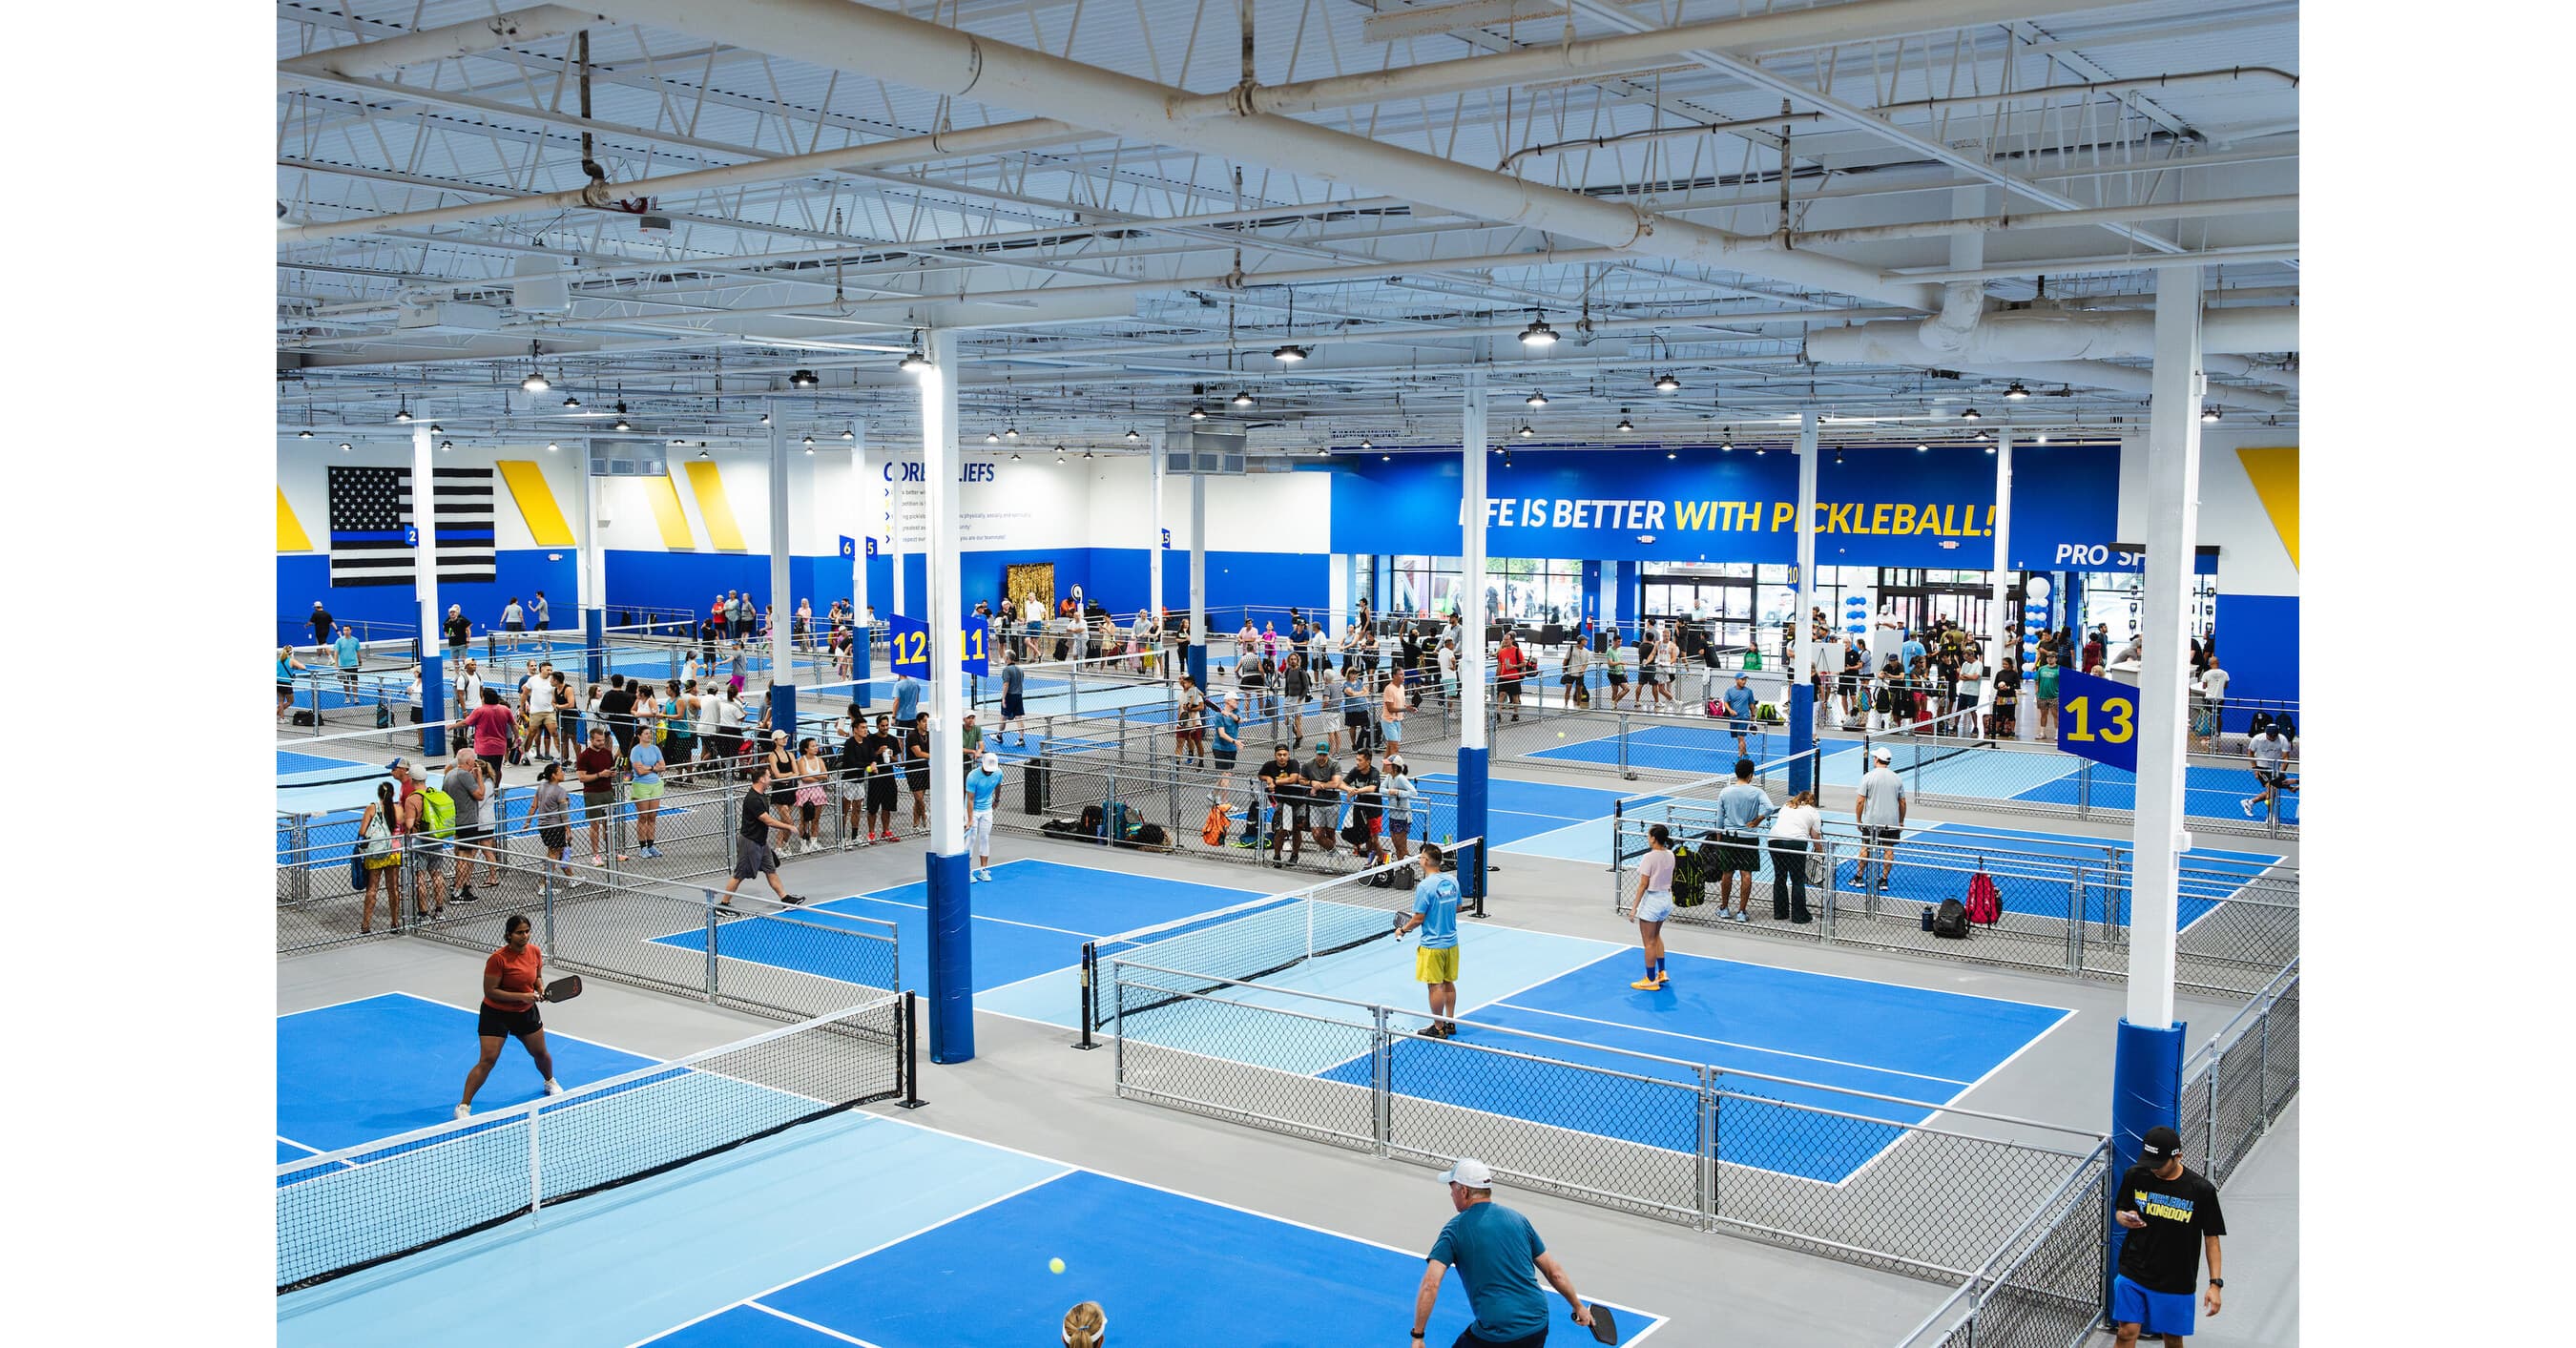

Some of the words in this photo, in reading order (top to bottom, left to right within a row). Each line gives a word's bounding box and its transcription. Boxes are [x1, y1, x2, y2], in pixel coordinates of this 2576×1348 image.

[959, 463, 995, 483] IEFS
[1458, 498, 1517, 527] FE
[1521, 498, 1548, 528] IS
[1552, 499, 1666, 530] BETTER
[1674, 501, 1763, 531] WITH
[408, 530, 417, 543] 2
[843, 541, 852, 555] 6
[867, 541, 875, 555] 5
[2055, 544, 2109, 566] PRO
[2117, 550, 2146, 566] SH
[1787, 566, 1799, 584] 10
[893, 631, 927, 665] 12
[961, 629, 986, 660] 11
[2065, 695, 2134, 743] 13
[2148, 1192, 2194, 1212] PICKLEBALL
[2146, 1203, 2193, 1224] KINGDOM
